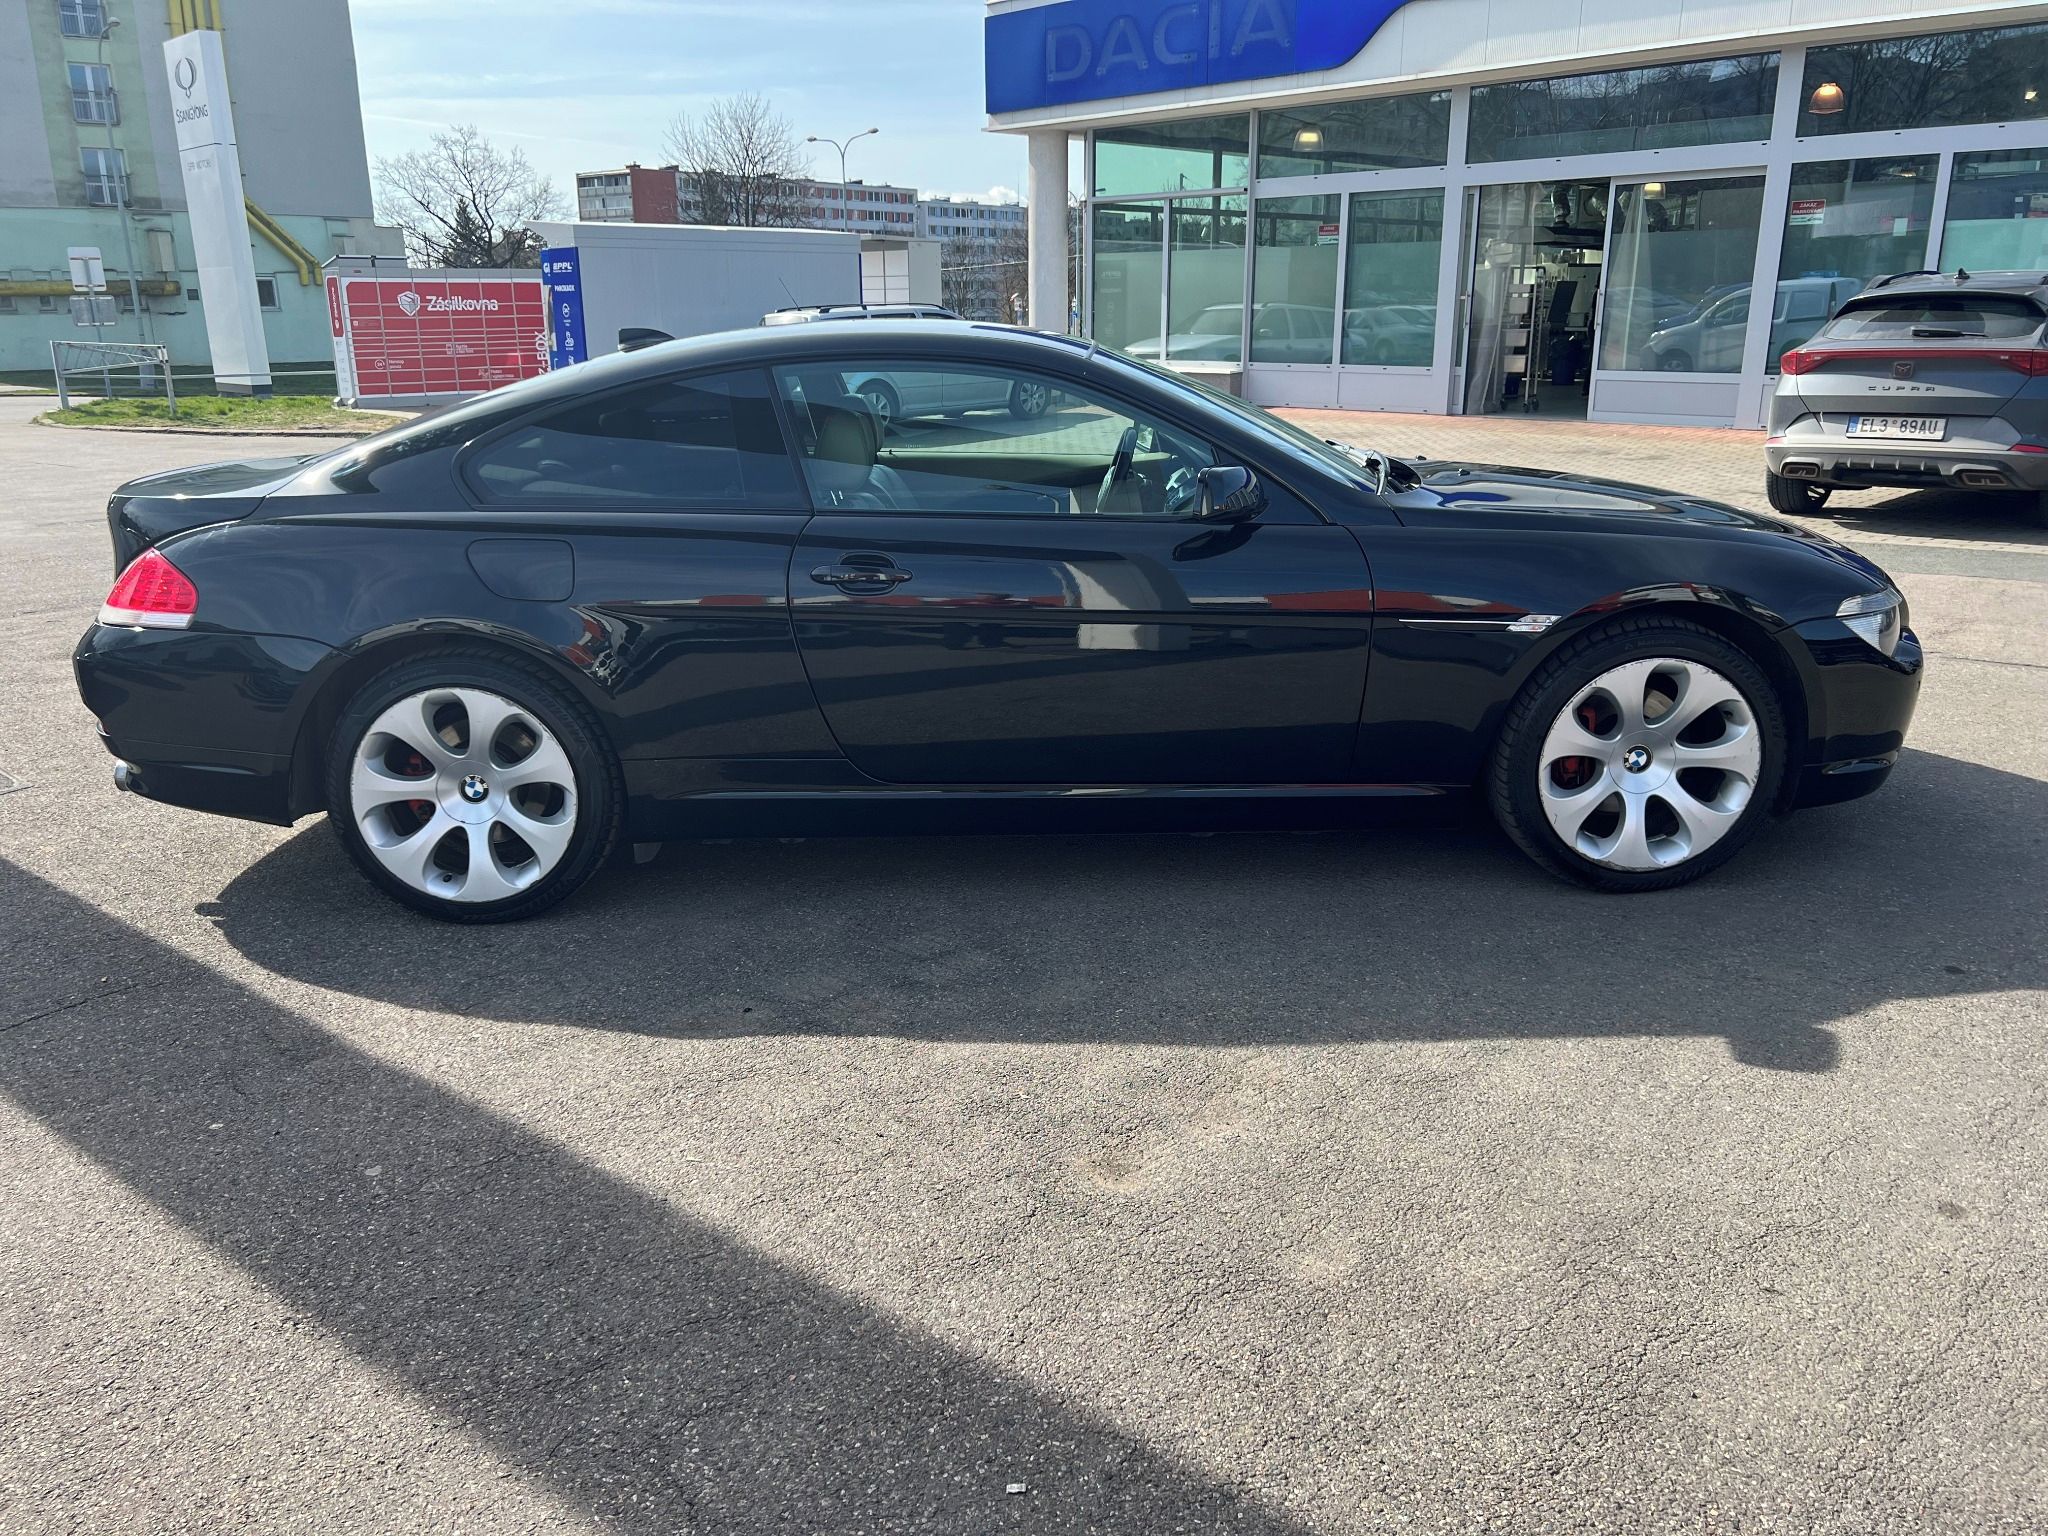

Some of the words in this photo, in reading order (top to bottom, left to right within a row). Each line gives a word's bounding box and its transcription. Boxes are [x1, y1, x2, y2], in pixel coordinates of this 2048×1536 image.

[1046, 0, 1294, 82] DACIA
[426, 295, 499, 311] Zásilkovna
[1860, 418, 1889, 433] EL3
[1899, 419, 1939, 435] 89AU
